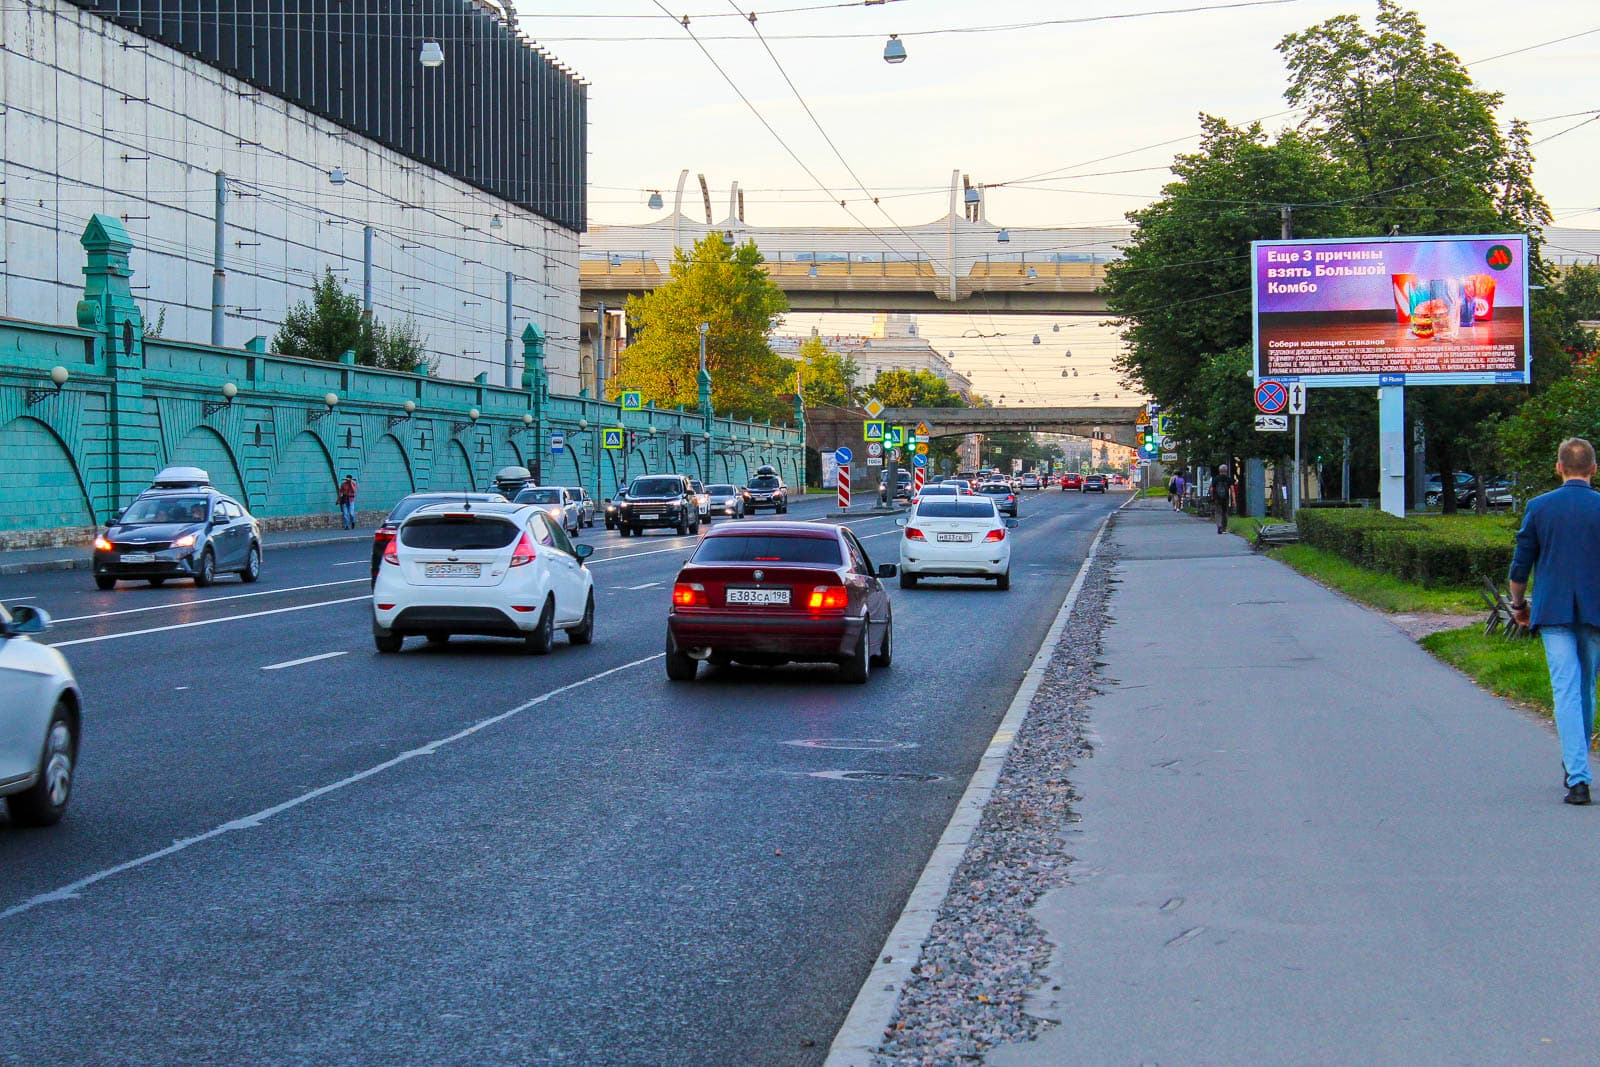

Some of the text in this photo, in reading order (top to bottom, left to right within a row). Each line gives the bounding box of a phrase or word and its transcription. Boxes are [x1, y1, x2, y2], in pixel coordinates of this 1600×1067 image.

[1267, 250, 1383, 263] Еще 3 причины
[1268, 262, 1386, 278] взять Большой
[1268, 281, 1317, 294] Комбо
[1268, 340, 1299, 348] Собери
[1301, 339, 1346, 348] коллекцию
[730, 591, 787, 601] Е383СА 198
